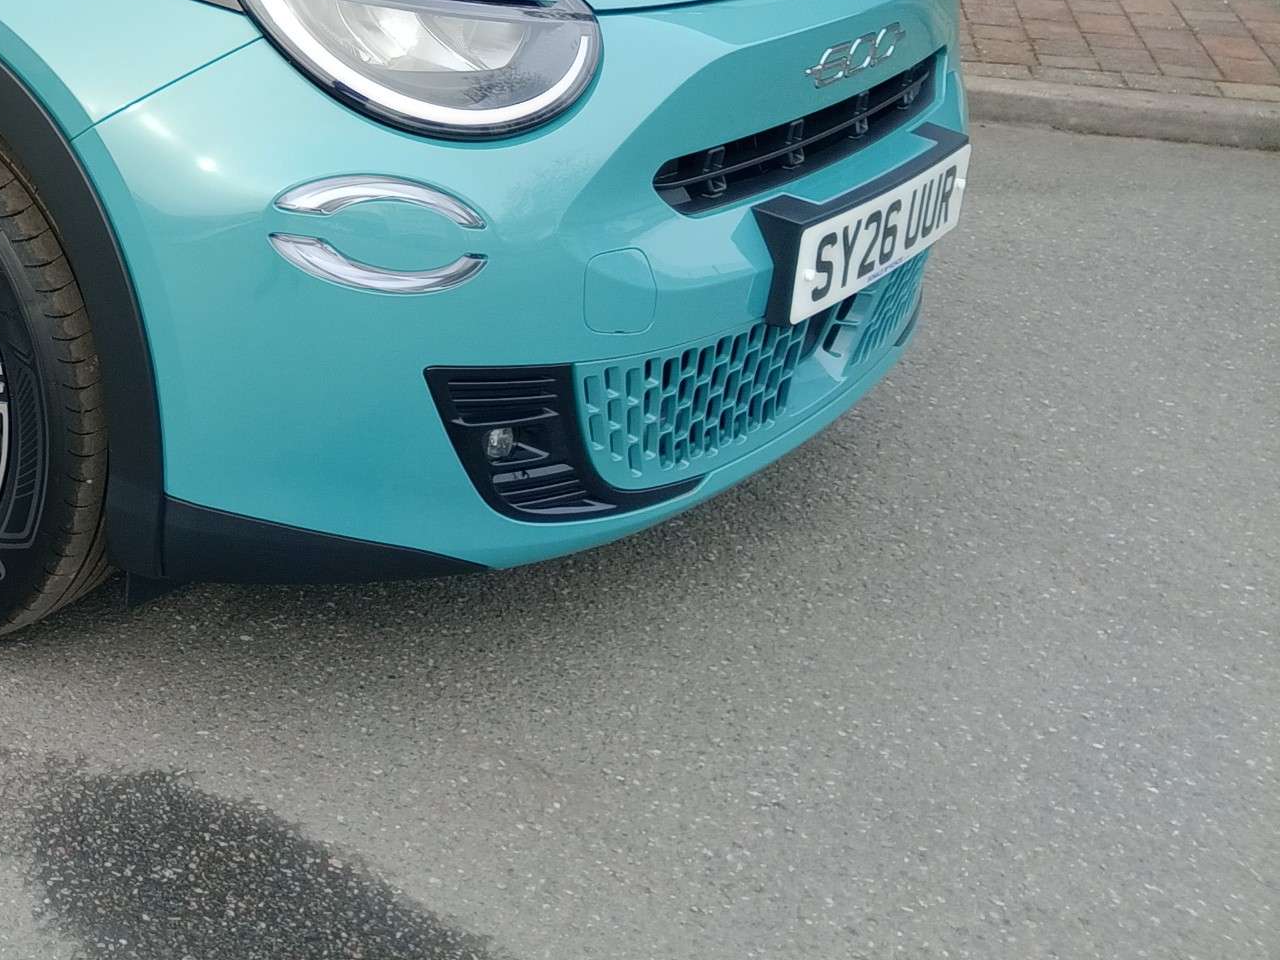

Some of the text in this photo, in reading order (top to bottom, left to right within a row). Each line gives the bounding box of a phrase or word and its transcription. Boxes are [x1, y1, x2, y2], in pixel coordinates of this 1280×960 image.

[808, 21, 906, 89] 600
[811, 164, 958, 303] SY26 UUR
